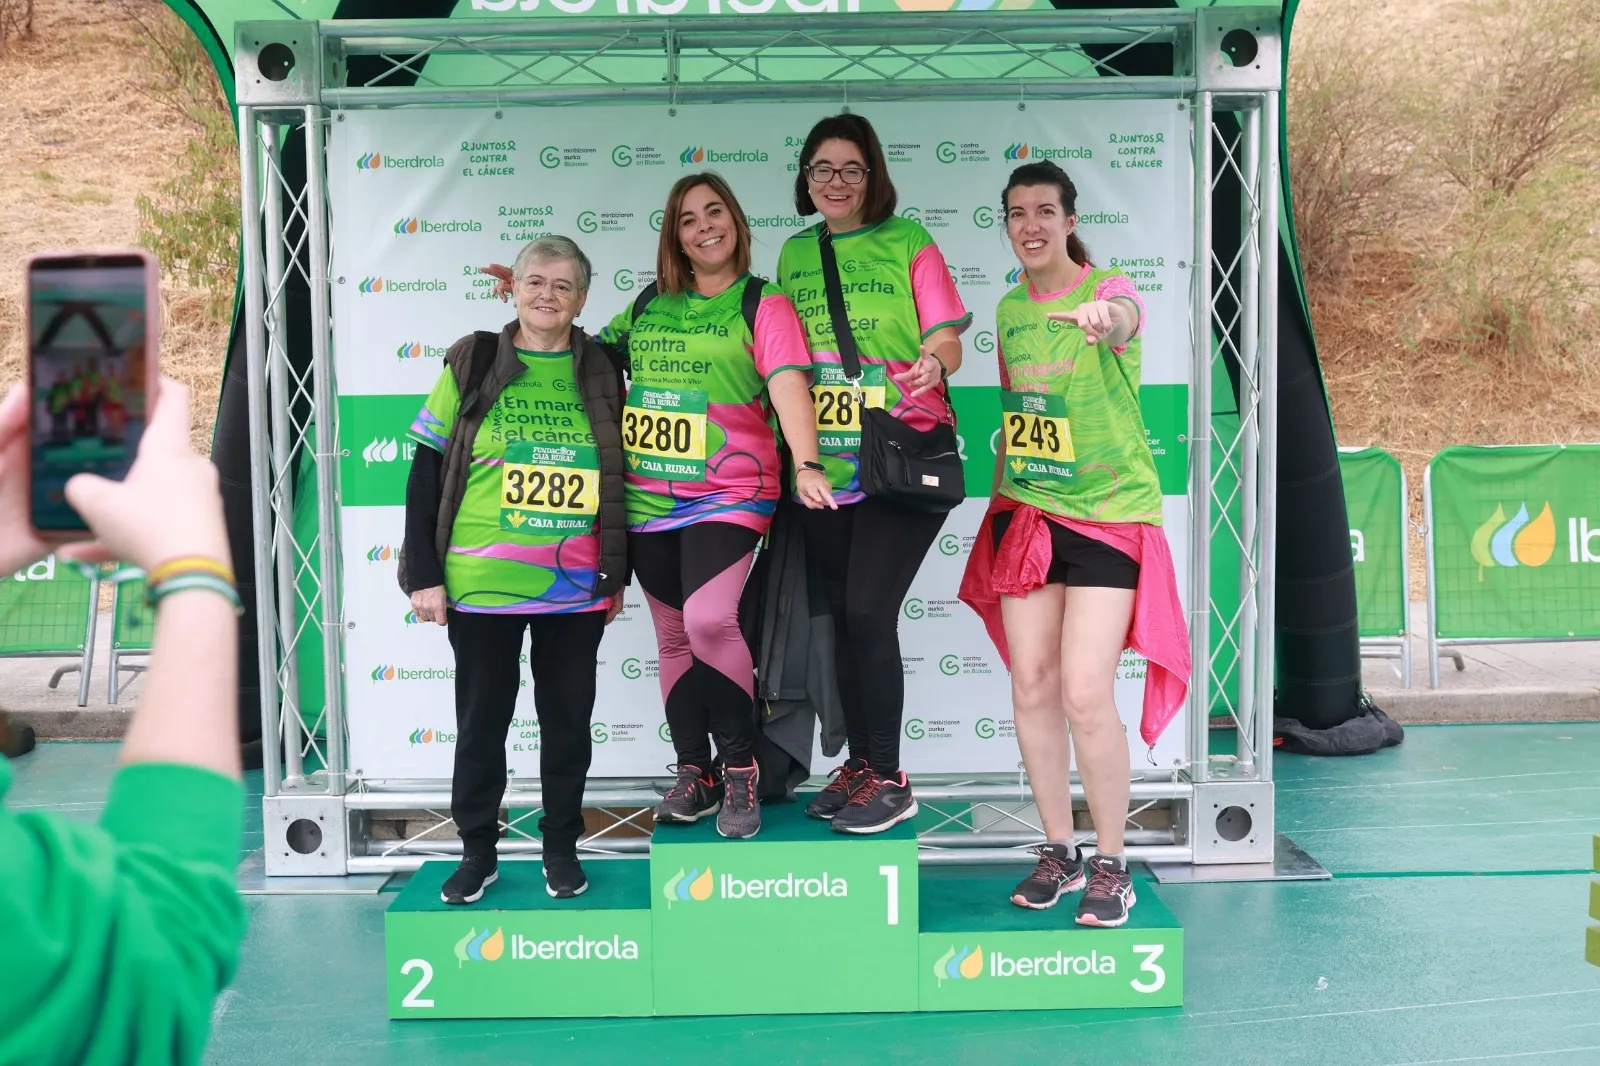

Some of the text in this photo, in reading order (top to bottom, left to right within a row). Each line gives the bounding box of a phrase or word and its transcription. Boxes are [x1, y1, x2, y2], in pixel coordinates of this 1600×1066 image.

[1119, 134, 1154, 143] JUNTOS
[470, 142, 506, 151] JUNTOS
[1031, 146, 1092, 160] Iberdrola
[1118, 146, 1155, 155] CONTRA
[384, 155, 444, 169] Iberdrola
[470, 154, 507, 163] CONTRA
[707, 149, 768, 163] Iberdrola
[1110, 157, 1163, 168] EL CÁNCER
[463, 165, 515, 176] EL CÁNCER
[787, 163, 798, 171] EL
[508, 206, 544, 216] JUNTOS
[1075, 211, 1129, 224] erdrola
[421, 219, 482, 233] Iberdrola
[507, 218, 545, 228] CONTRA
[747, 214, 806, 227] berdrola
[501, 233, 513, 241] EL
[1119, 257, 1155, 267] JUNTOS
[802, 268, 823, 278] Iberd
[1124, 270, 1156, 279] ONTRA
[386, 278, 447, 292] Iberdrola
[472, 279, 501, 287] CONT
[1134, 281, 1163, 292] NCER
[465, 292, 476, 300] EL
[797, 288, 817, 303] En
[797, 301, 851, 320] cona
[658, 321, 729, 338] marcha
[814, 317, 879, 336] cácer
[631, 337, 686, 353] contra
[632, 355, 712, 374] el cáncer
[1022, 357, 1074, 377] march
[504, 396, 585, 413] En marc
[504, 413, 573, 427] contra
[504, 425, 596, 444] el cánce
[625, 412, 691, 454] 3280
[1009, 414, 1060, 453] 243
[819, 437, 842, 446] CAJA
[532, 453, 575, 463] CAJA RURAL
[642, 460, 700, 475] CAJA RURAL
[1028, 462, 1073, 477] CAJA RURAL
[506, 469, 585, 509] 3282
[528, 517, 588, 529] CAJA RURAL
[1118, 659, 1147, 668] CONTR
[1125, 669, 1147, 679] CÁNC
[521, 718, 538, 727] JUN
[520, 731, 538, 739] CON
[513, 743, 524, 751] EL
[720, 872, 848, 899] Iberdrola
[879, 865, 898, 925] 1
[511, 934, 638, 960] Iberdrola
[990, 950, 1116, 977] Iberdrola
[1130, 944, 1165, 993] 3
[400, 958, 434, 1008] 2
